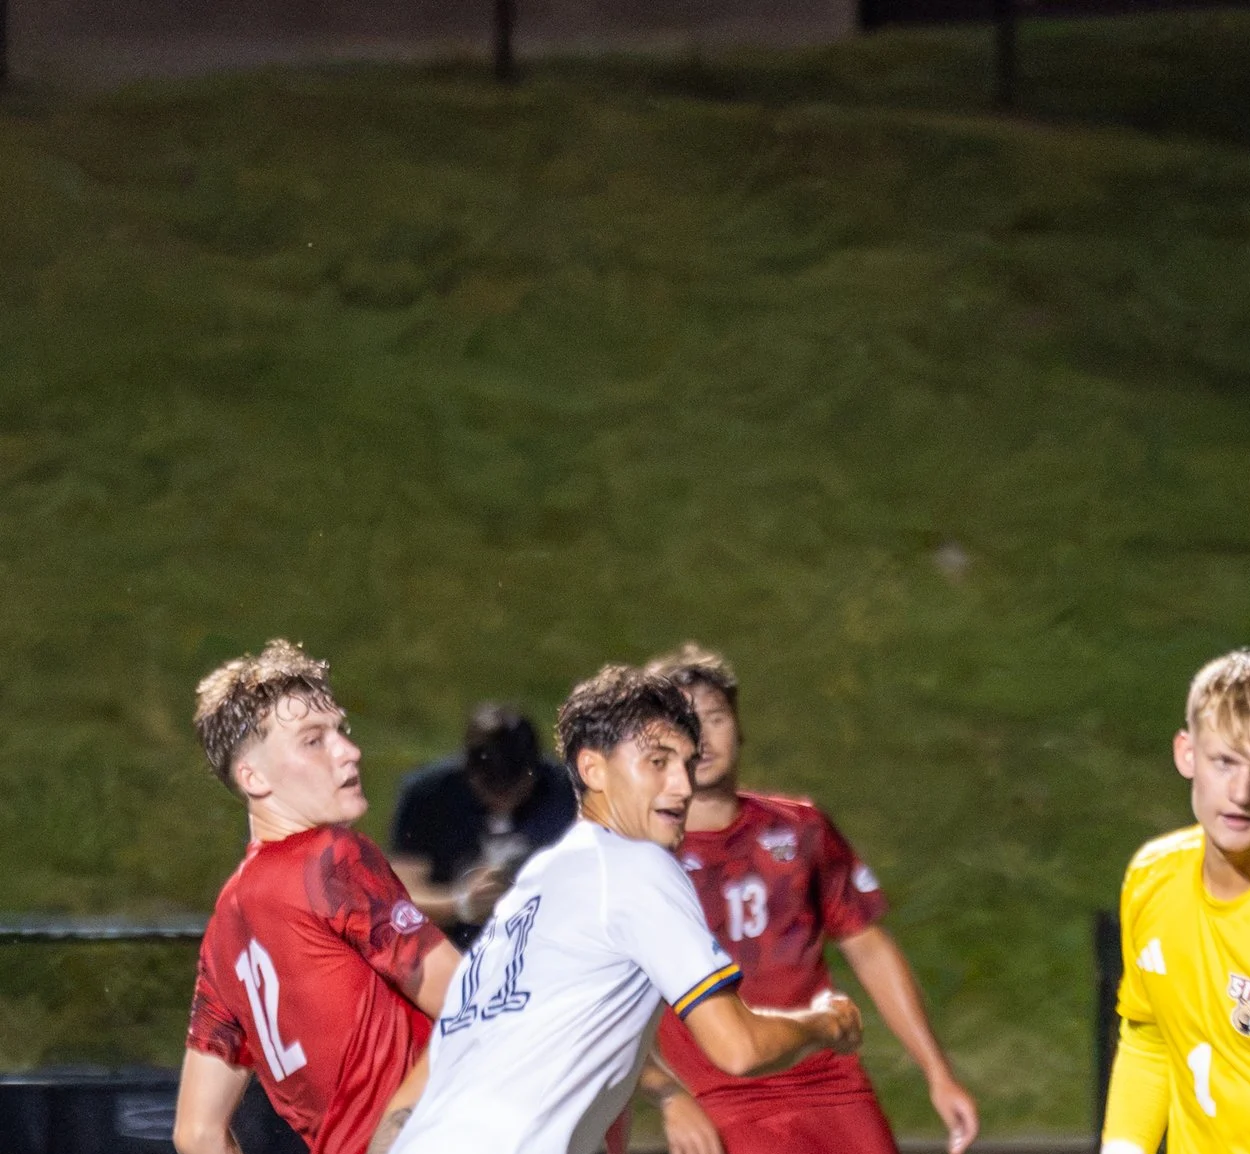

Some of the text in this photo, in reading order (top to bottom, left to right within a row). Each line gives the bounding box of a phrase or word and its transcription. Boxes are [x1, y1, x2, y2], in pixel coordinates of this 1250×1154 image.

[725, 876, 768, 942] 13
[234, 937, 308, 1083] 12
[440, 895, 542, 1037] 11
[1187, 1042, 1217, 1118] 1
